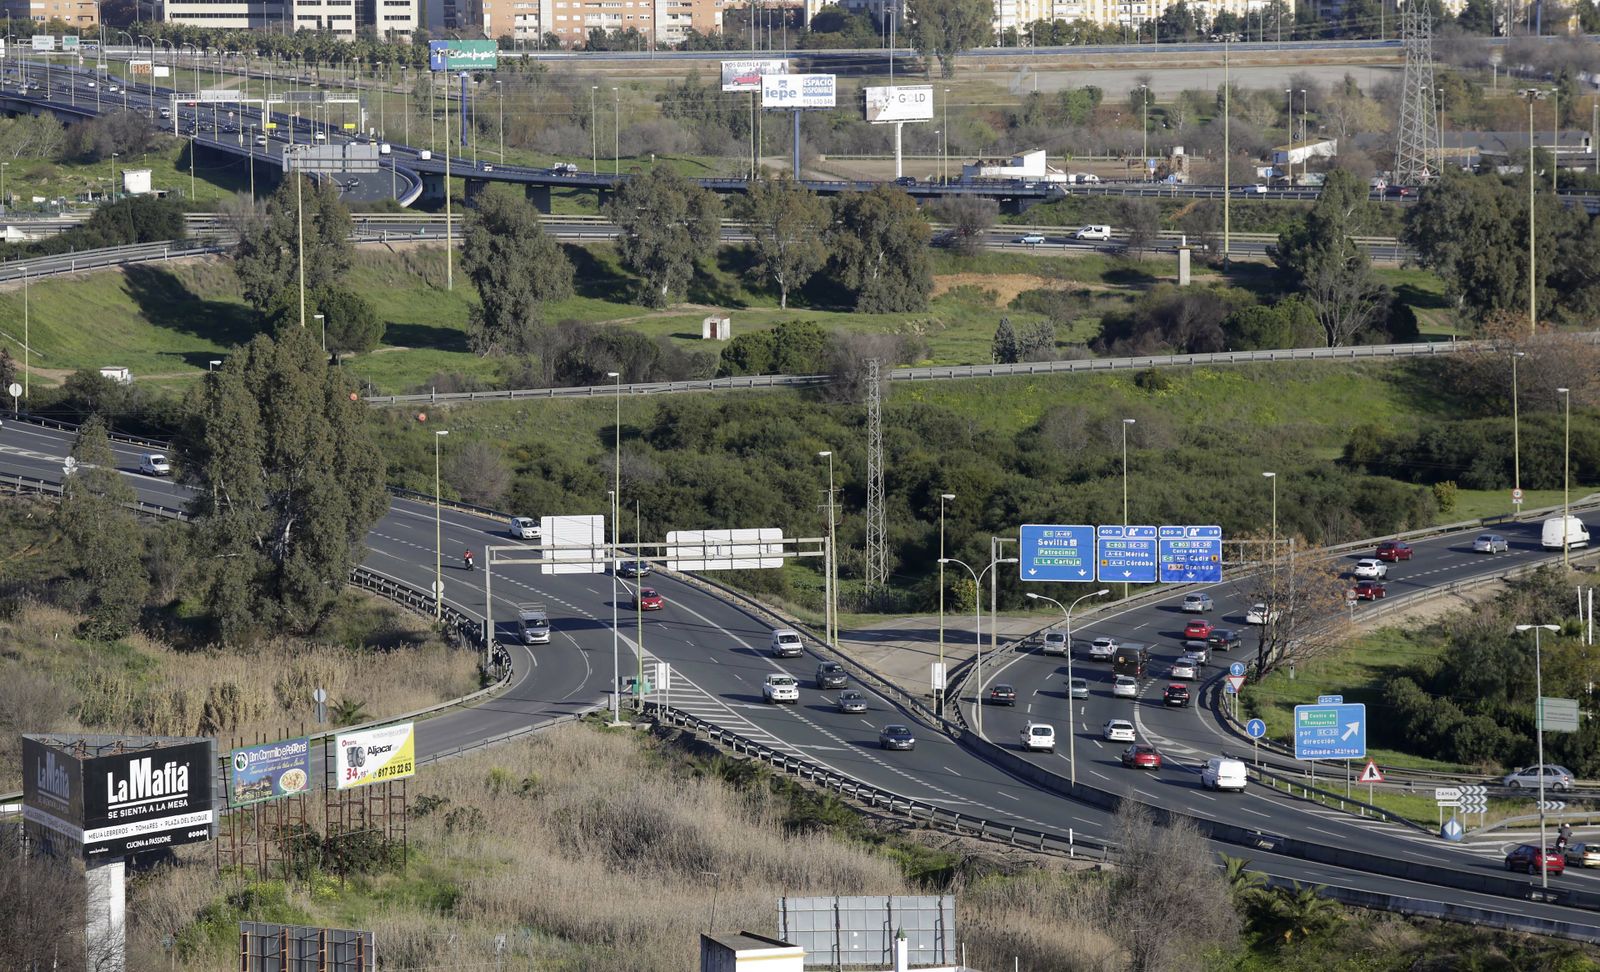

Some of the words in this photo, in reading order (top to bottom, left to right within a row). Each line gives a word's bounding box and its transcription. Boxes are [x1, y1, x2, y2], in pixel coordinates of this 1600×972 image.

[765, 88, 797, 100] iepe
[367, 744, 392, 756] Aljacar
[397, 764, 404, 773] 22
[108, 810, 118, 820] SE
[120, 807, 147, 818] SIENTA
[156, 803, 166, 812] LA
[168, 799, 188, 809] MESA
[104, 828, 128, 838] LEBREROS
[135, 822, 158, 832] TOMARES
[165, 818, 180, 827] PLAZA
[190, 814, 207, 823] DUQUE
[126, 840, 144, 849] CUCINA
[149, 835, 172, 844] PASSIONE
